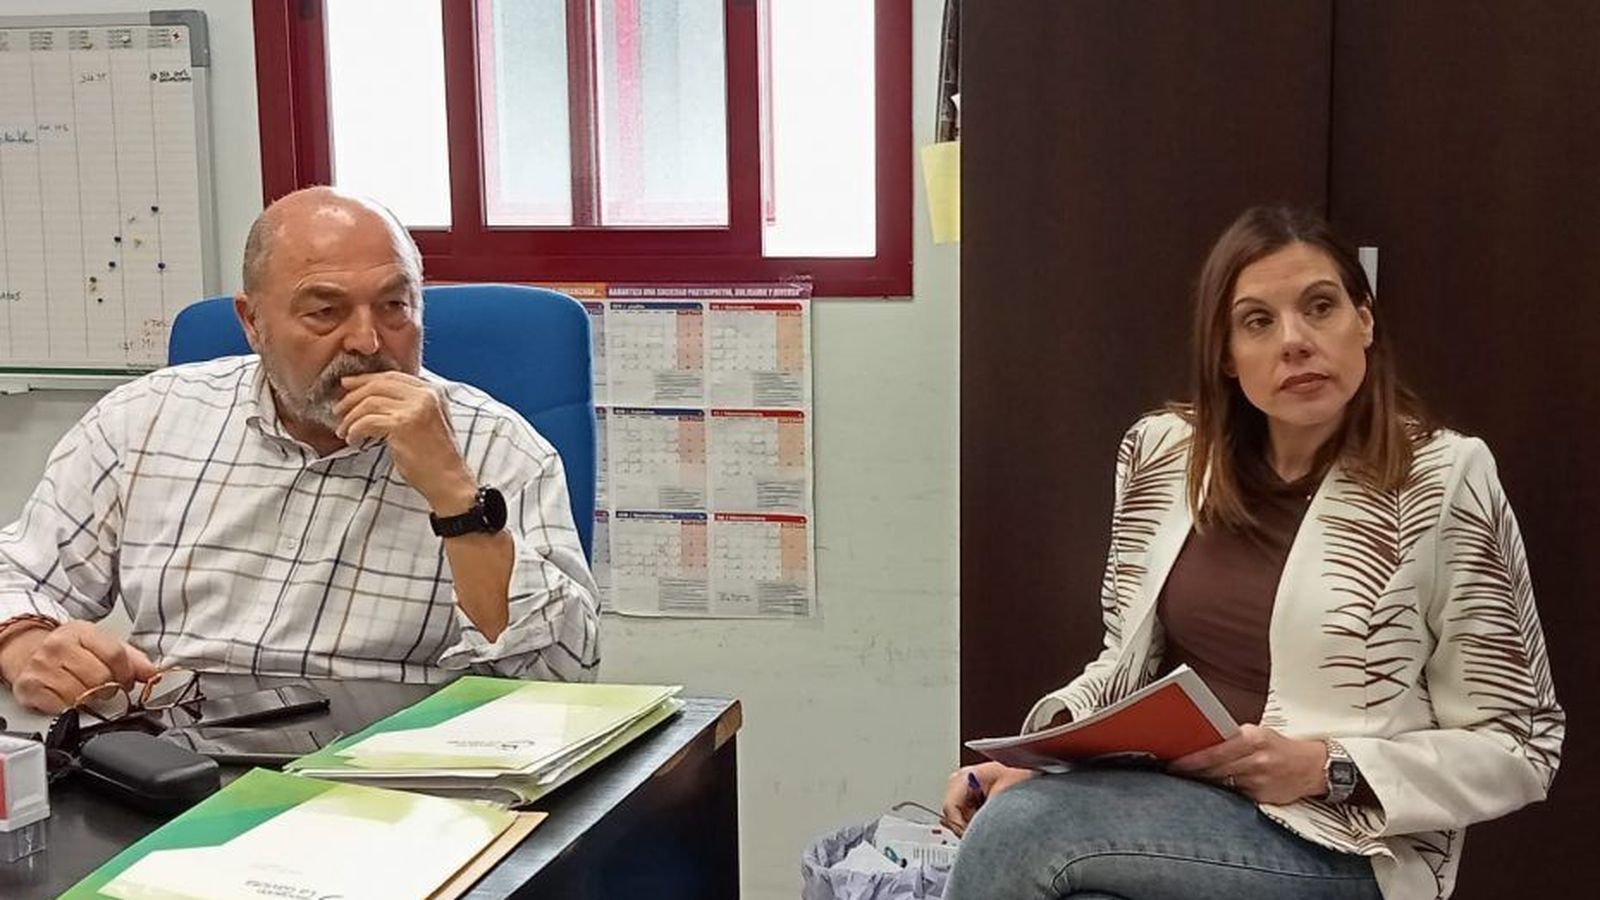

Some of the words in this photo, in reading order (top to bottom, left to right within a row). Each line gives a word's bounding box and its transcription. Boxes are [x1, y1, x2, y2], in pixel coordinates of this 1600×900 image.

[608, 288, 642, 296] GARANTIZA
[643, 288, 656, 296] UNA
[656, 288, 687, 296] SOCIEDAD
